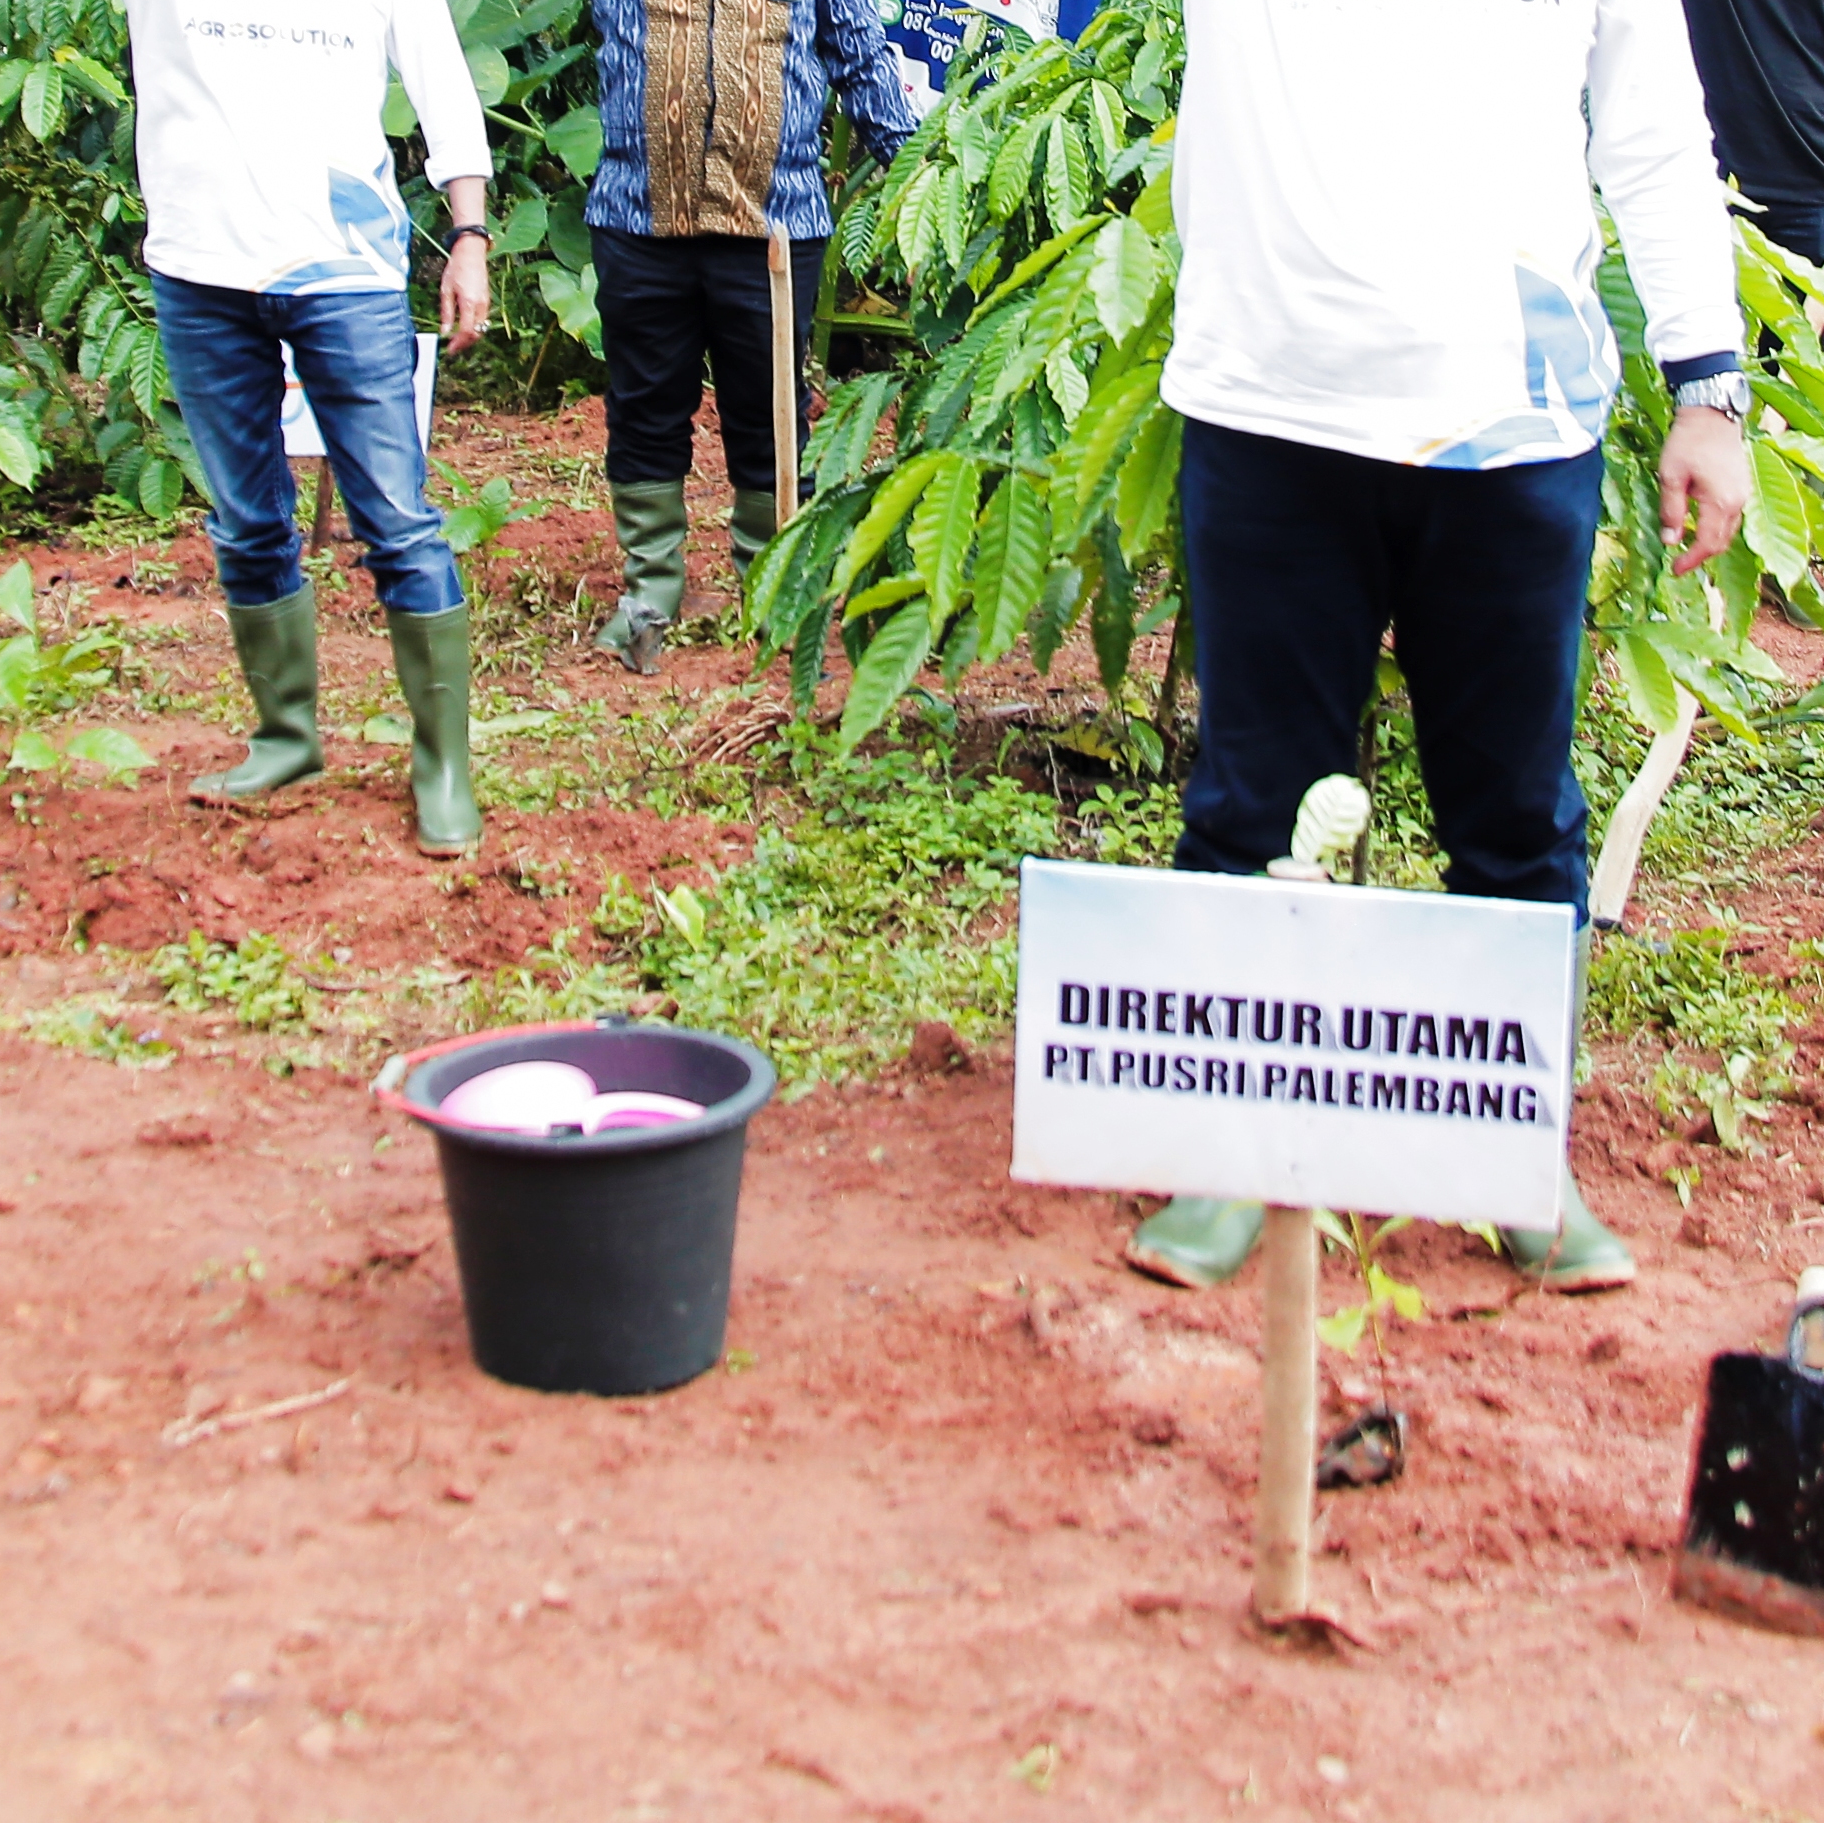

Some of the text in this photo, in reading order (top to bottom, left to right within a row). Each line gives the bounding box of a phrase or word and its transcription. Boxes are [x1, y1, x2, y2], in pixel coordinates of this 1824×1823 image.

[1059, 983, 1528, 1065] DIREKTUR UTAMA
[1044, 1043, 1538, 1123] PT PUSRI PALEMBANG
